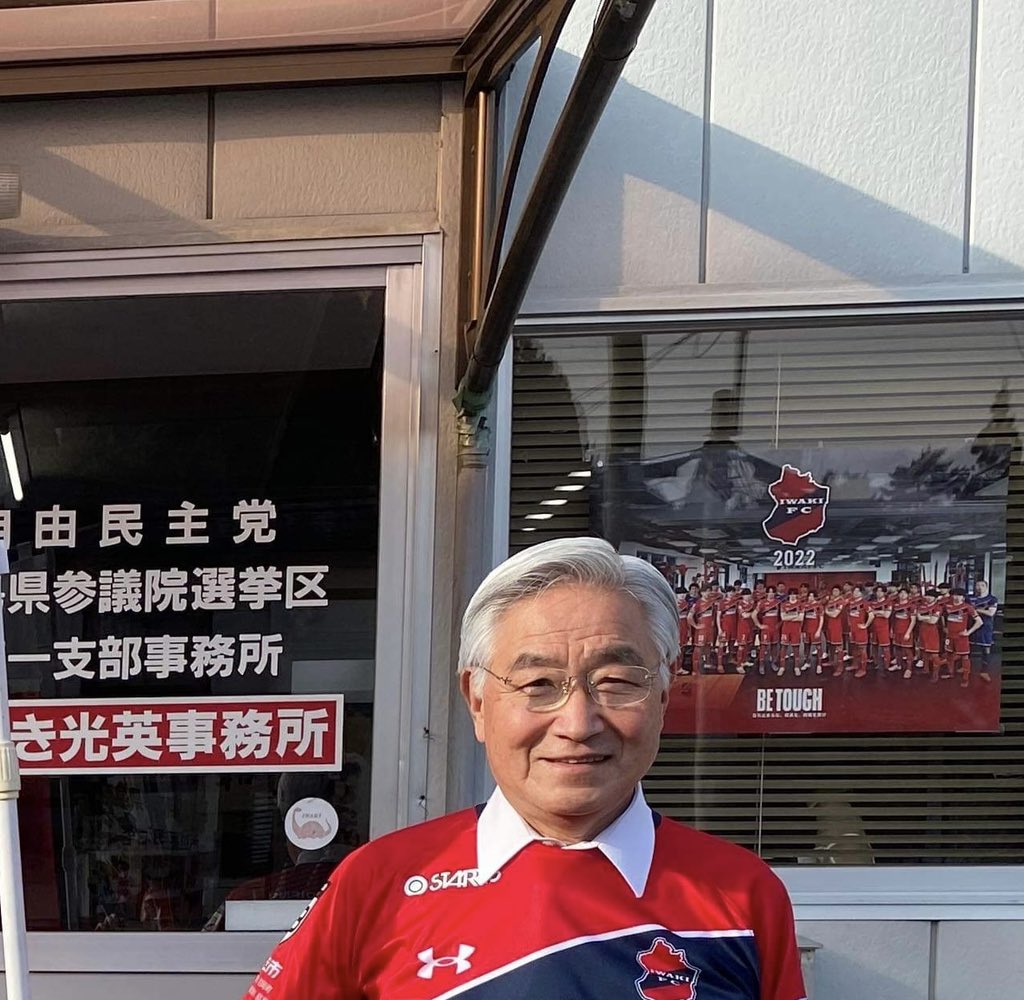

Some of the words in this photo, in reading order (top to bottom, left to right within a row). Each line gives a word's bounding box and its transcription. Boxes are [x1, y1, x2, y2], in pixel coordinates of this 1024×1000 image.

[773, 549, 815, 567] 2022
[757, 688, 774, 711] BE
[775, 688, 823, 711] TOUGH
[429, 868, 502, 892] STAR
[650, 969, 690, 983] IWAKI
